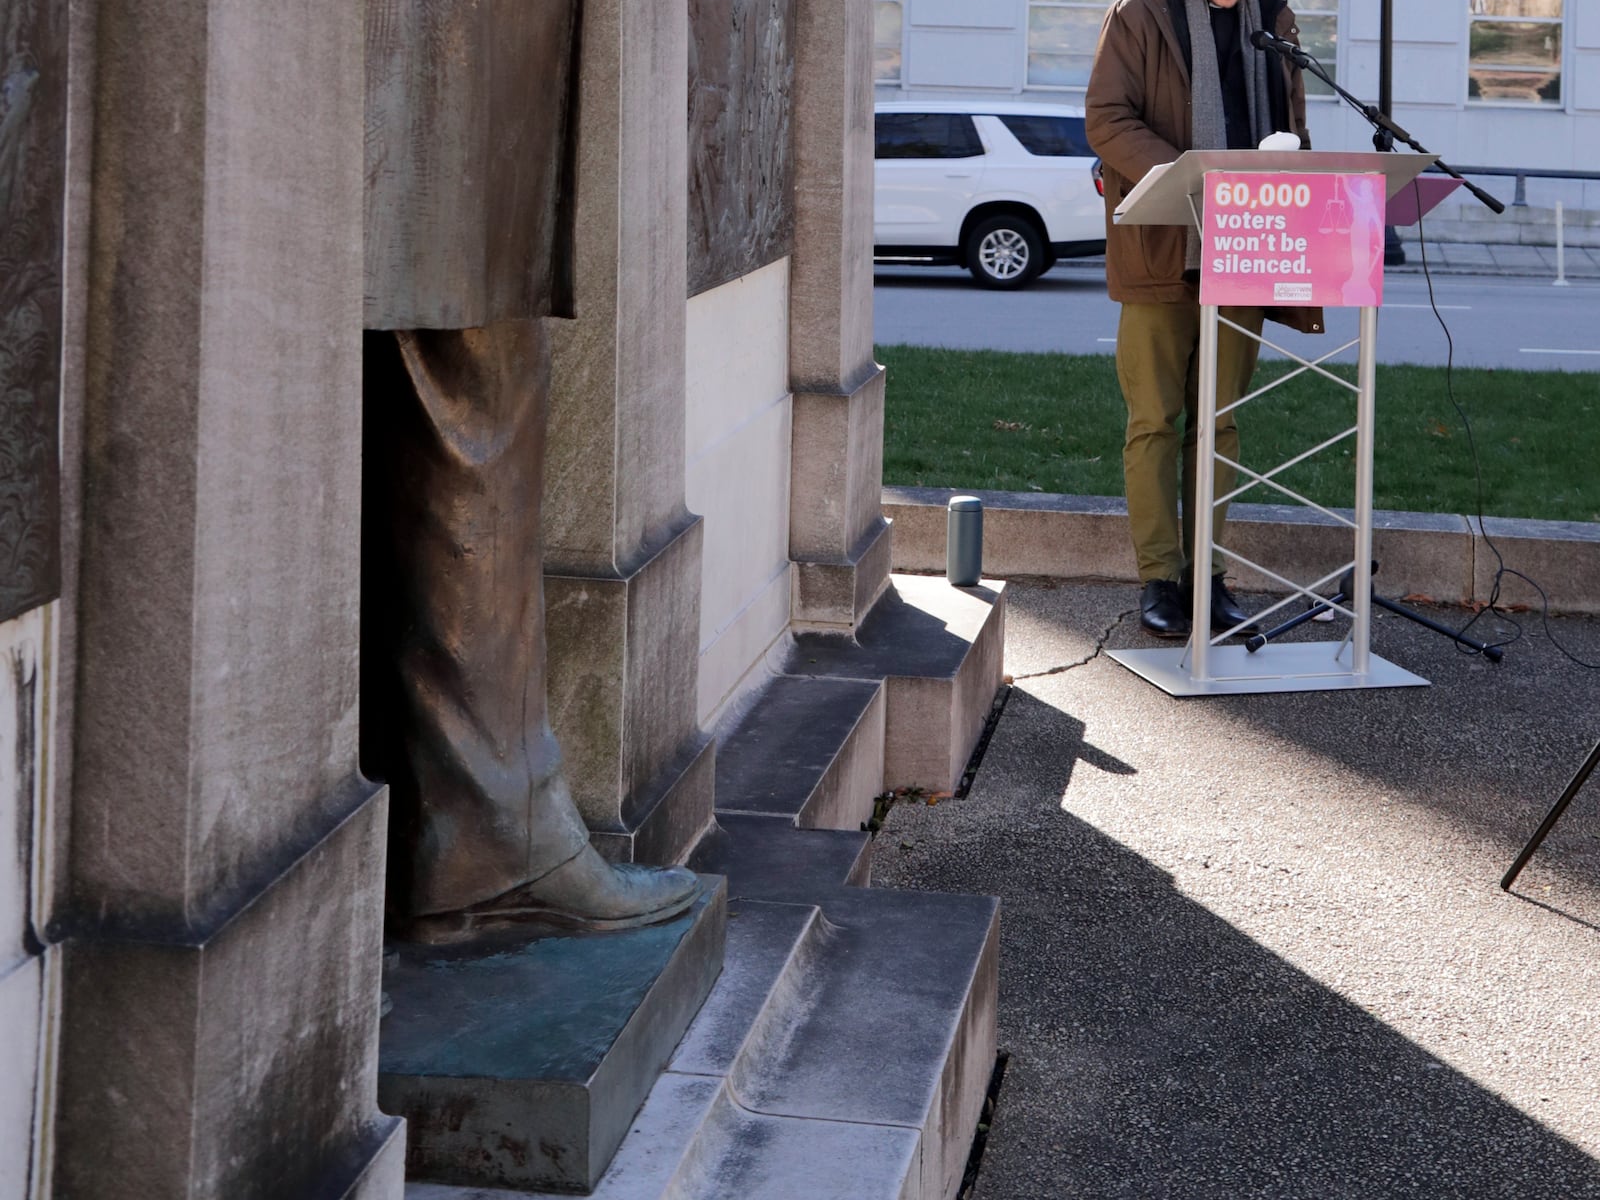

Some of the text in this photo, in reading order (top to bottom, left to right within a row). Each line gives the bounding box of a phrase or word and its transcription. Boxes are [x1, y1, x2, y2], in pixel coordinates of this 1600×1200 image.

[1215, 182, 1311, 209] 60,000
[1215, 211, 1286, 230] voters
[1214, 232, 1308, 252] won't be
[1212, 254, 1312, 274] silenced.
